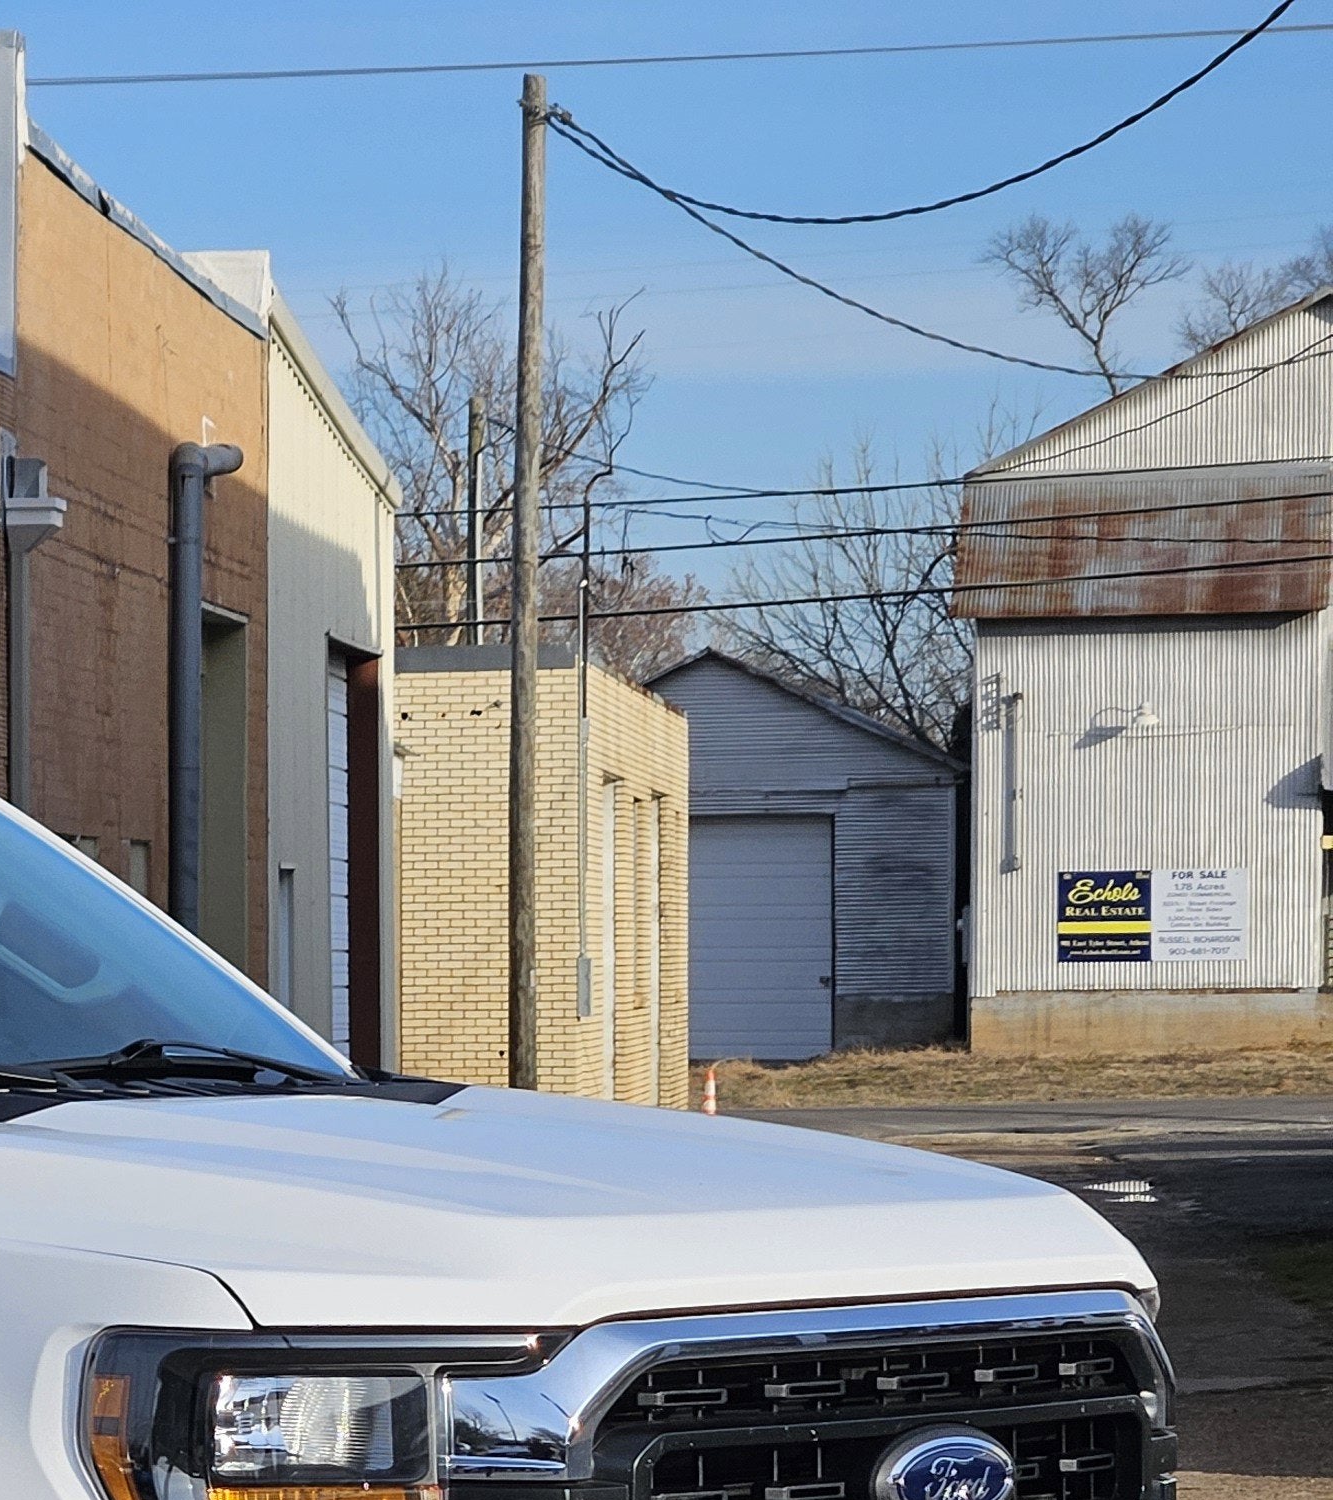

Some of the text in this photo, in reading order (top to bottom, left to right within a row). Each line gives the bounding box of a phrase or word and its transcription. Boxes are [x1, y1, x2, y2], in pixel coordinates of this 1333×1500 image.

[1171, 870, 1228, 880] FOR SALE
[1068, 879, 1142, 904] Echols
[1196, 883, 1226, 891] Acres
[1065, 905, 1146, 917] REAL ESTATE
